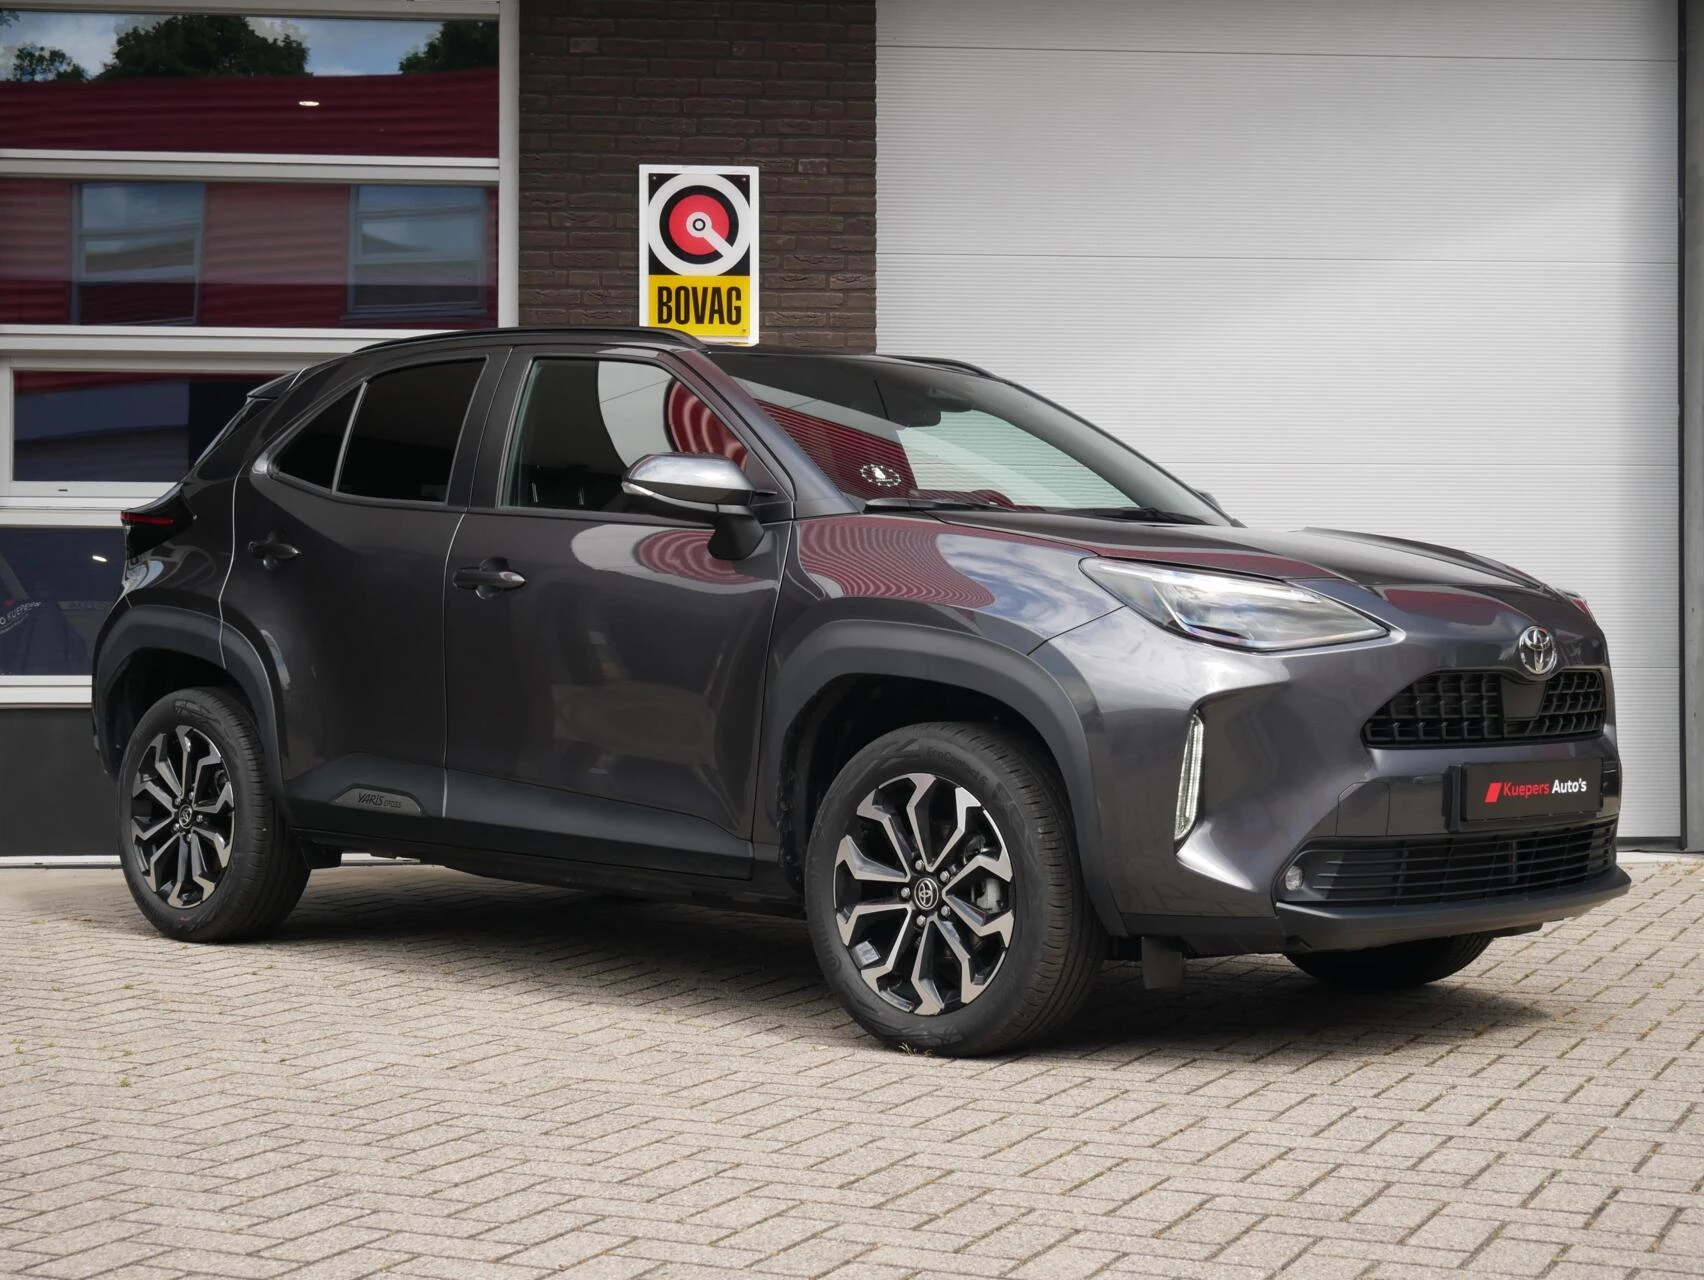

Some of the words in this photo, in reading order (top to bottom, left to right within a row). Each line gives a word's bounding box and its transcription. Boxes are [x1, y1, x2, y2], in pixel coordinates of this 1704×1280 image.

[657, 285, 742, 326] BOVAG
[1503, 782, 1550, 799] Kuepers
[1552, 778, 1587, 794] Auto's
[358, 792, 384, 807] YARIS
